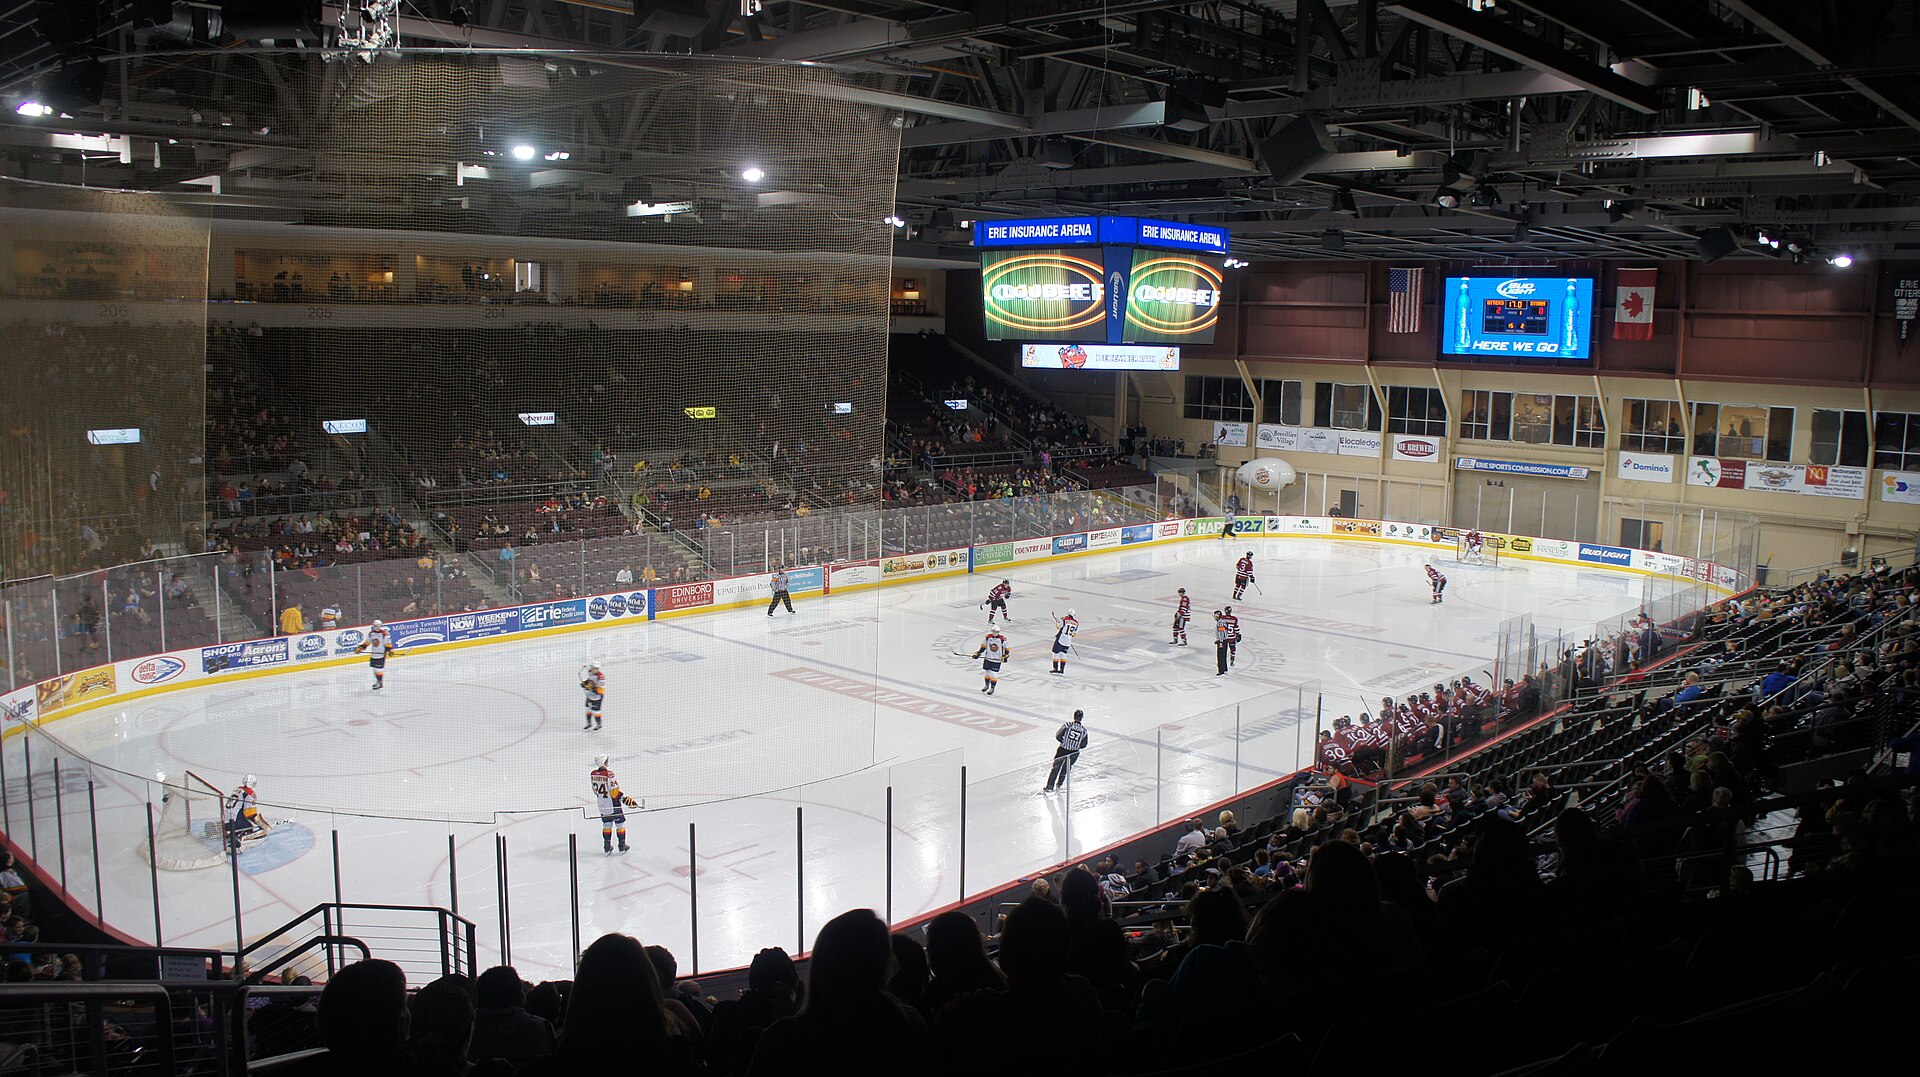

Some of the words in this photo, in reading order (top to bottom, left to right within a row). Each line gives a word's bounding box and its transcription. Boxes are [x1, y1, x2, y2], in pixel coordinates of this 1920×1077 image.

[988, 227, 1007, 239] ERIE
[1009, 225, 1059, 238] INSURANCE
[1060, 223, 1092, 236] ARENA
[1142, 225, 1159, 238] ERIE
[1160, 226, 1198, 243] INSURANCE
[1199, 231, 1222, 247] ARENA
[1900, 280, 1918, 288] ERIE
[99, 304, 129, 318] 206
[308, 307, 333, 319] 205
[1472, 340, 1509, 351] HERE
[1513, 342, 1534, 351] WE
[1536, 342, 1559, 353] GO
[1276, 437, 1295, 446] Village
[1344, 437, 1381, 448] localedge
[1633, 463, 1669, 473] Domino's
[1234, 520, 1263, 532] 92.7
[1058, 537, 1074, 547] CLASSY
[1014, 545, 1039, 555] COUNTRY
[1040, 543, 1052, 552] FAIR
[1580, 547, 1601, 556] BUD
[1602, 550, 1630, 560] LIGHT
[982, 550, 1012, 560] UNIVERSITY
[1239, 563, 1246, 571] 3
[672, 584, 712, 598] EDINBORO
[717, 588, 737, 596] UPMC
[672, 593, 711, 604] UNIVERSITY
[477, 611, 518, 621] WEEKEND
[536, 605, 561, 622] Erie
[392, 623, 419, 632] Millcreek
[421, 619, 447, 628] Township
[450, 619, 475, 630] NOW
[1227, 623, 1235, 633] 5
[341, 631, 358, 641] FOX
[399, 628, 419, 636] School
[419, 625, 441, 634] District
[1064, 625, 1076, 637] 19
[302, 636, 319, 646] FOX
[203, 645, 242, 658] SHOOT
[243, 642, 287, 656] Aaron's
[252, 652, 287, 664] SAVE!
[138, 662, 156, 673] delta
[139, 671, 156, 681] sonic
[858, 688, 1019, 732] COUNTRY
[1069, 730, 1080, 741] 57
[1325, 747, 1345, 762] 30
